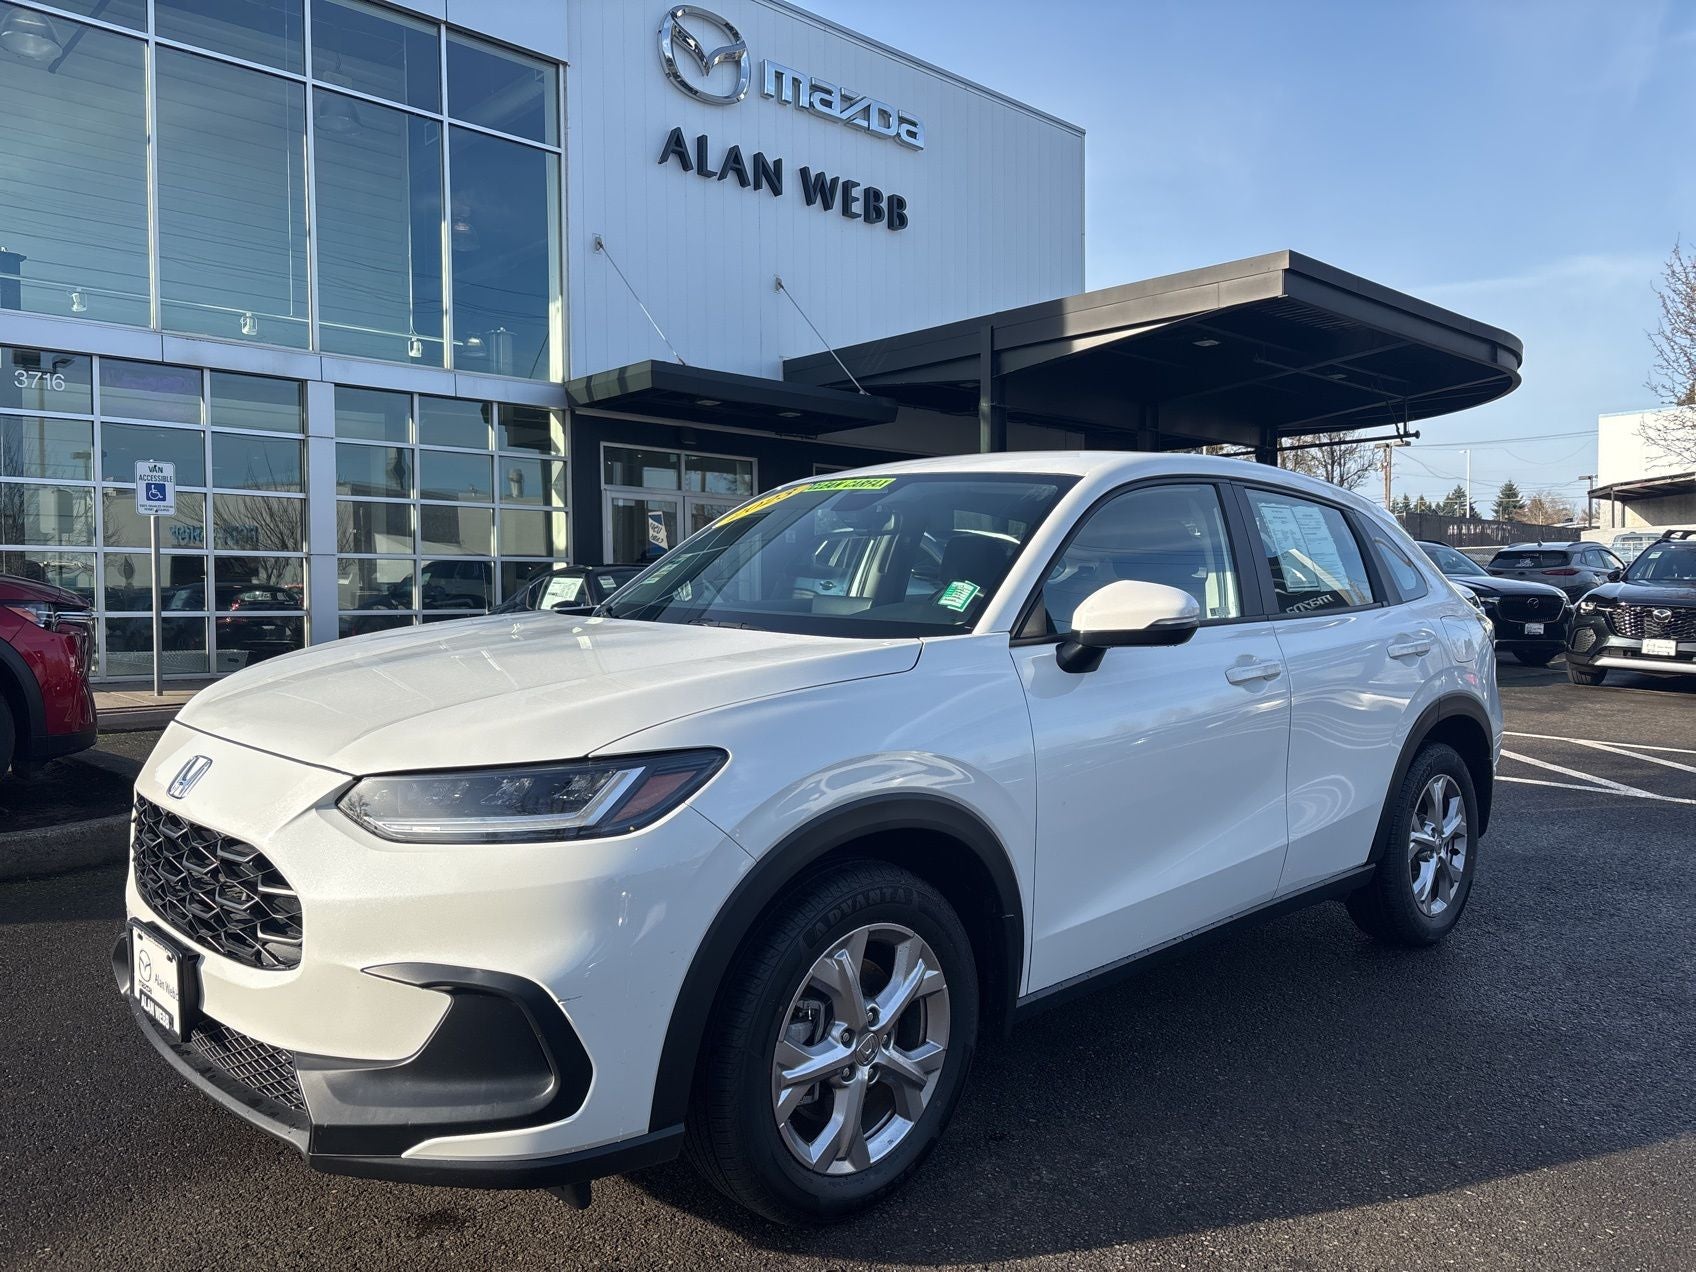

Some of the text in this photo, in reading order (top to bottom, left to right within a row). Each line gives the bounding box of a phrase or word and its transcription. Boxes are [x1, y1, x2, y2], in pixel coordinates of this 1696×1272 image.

[658, 126, 909, 231] ALAN WEBB
[14, 369, 65, 391] 3716
[148, 464, 164, 473] VAN
[139, 474, 173, 483] ACCESSIBLE
